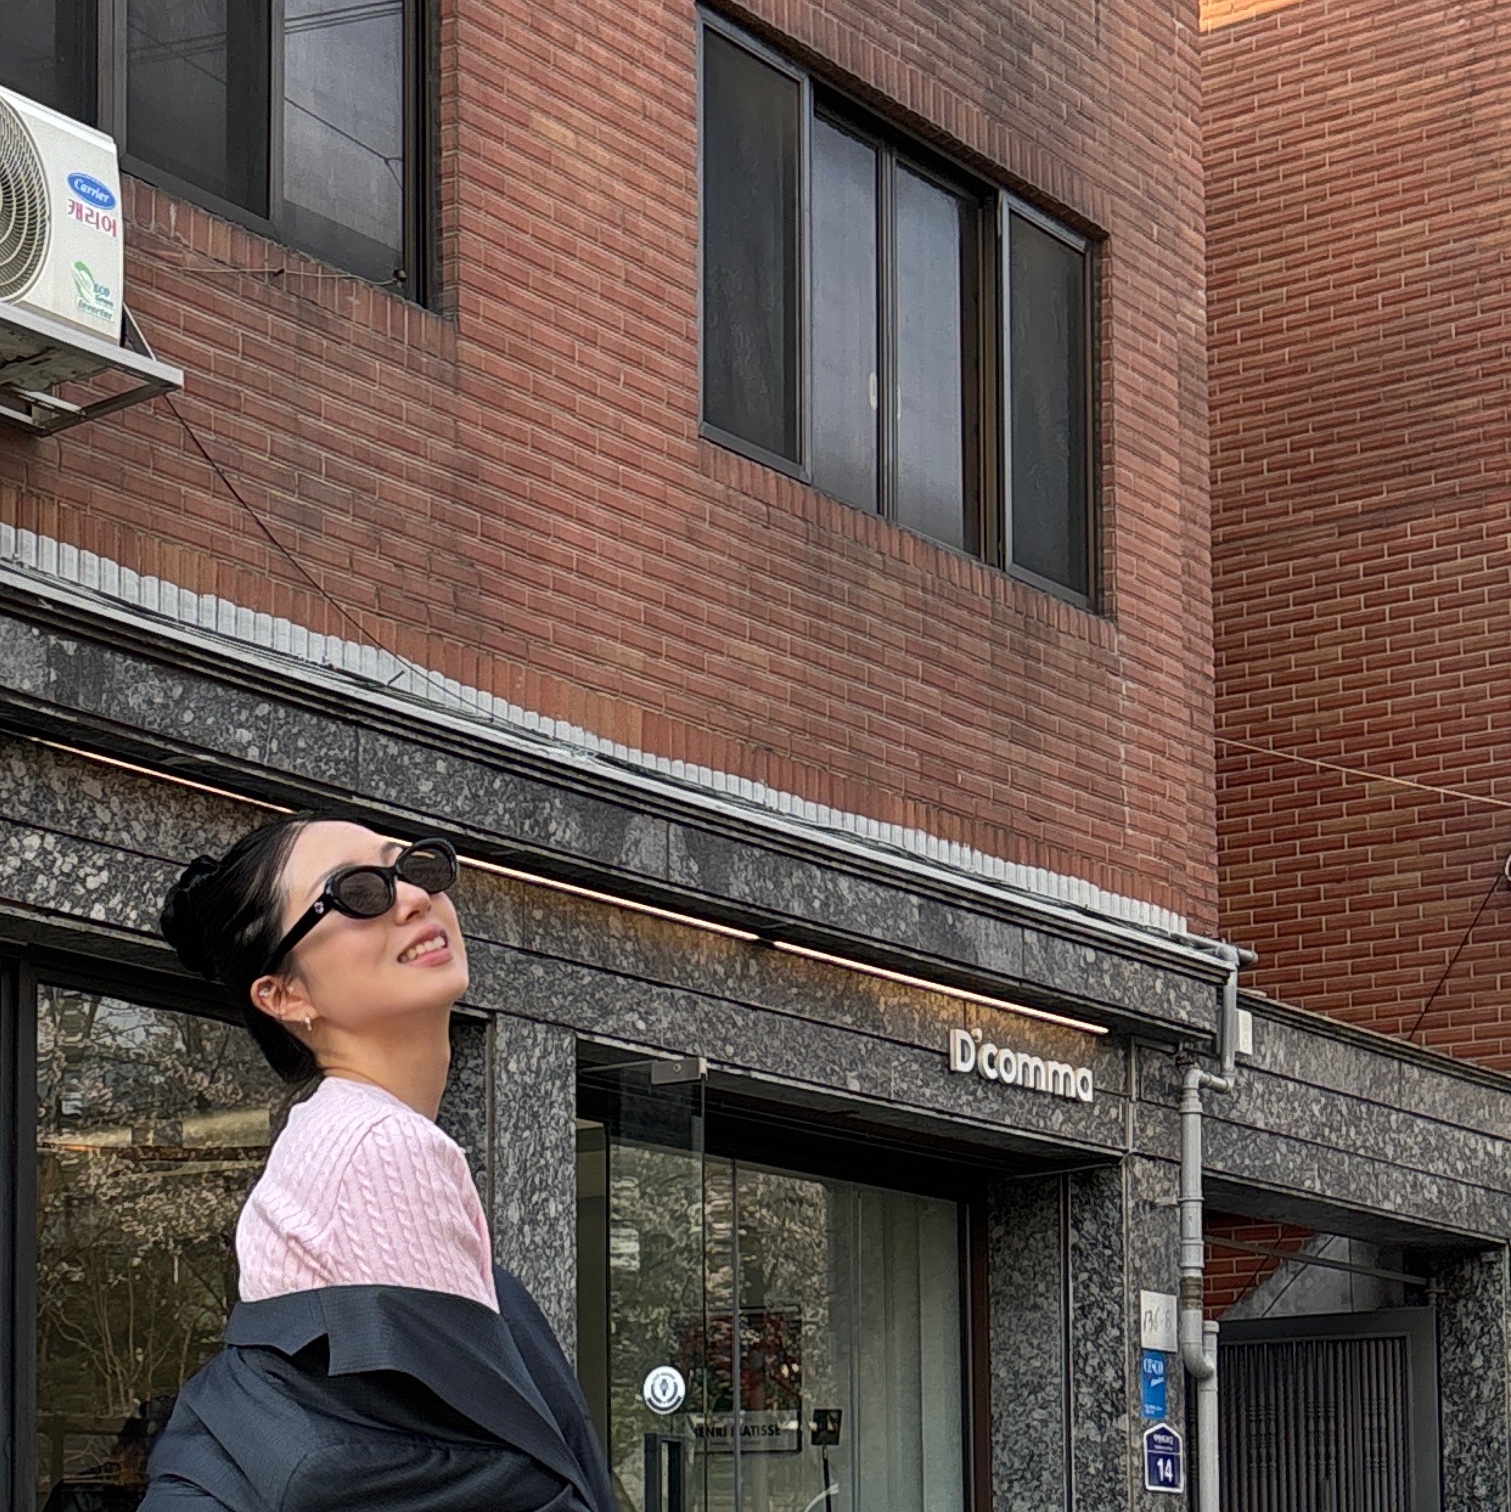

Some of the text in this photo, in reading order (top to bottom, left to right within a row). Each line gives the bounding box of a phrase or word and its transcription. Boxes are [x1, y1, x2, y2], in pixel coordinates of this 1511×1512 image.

[73, 178, 110, 203] Carrier
[67, 198, 117, 238] 캐리어
[94, 283, 110, 297] ECO
[78, 299, 113, 320] Inverter
[950, 1028, 1093, 1102] D'comma
[1156, 1457, 1173, 1483] 14
